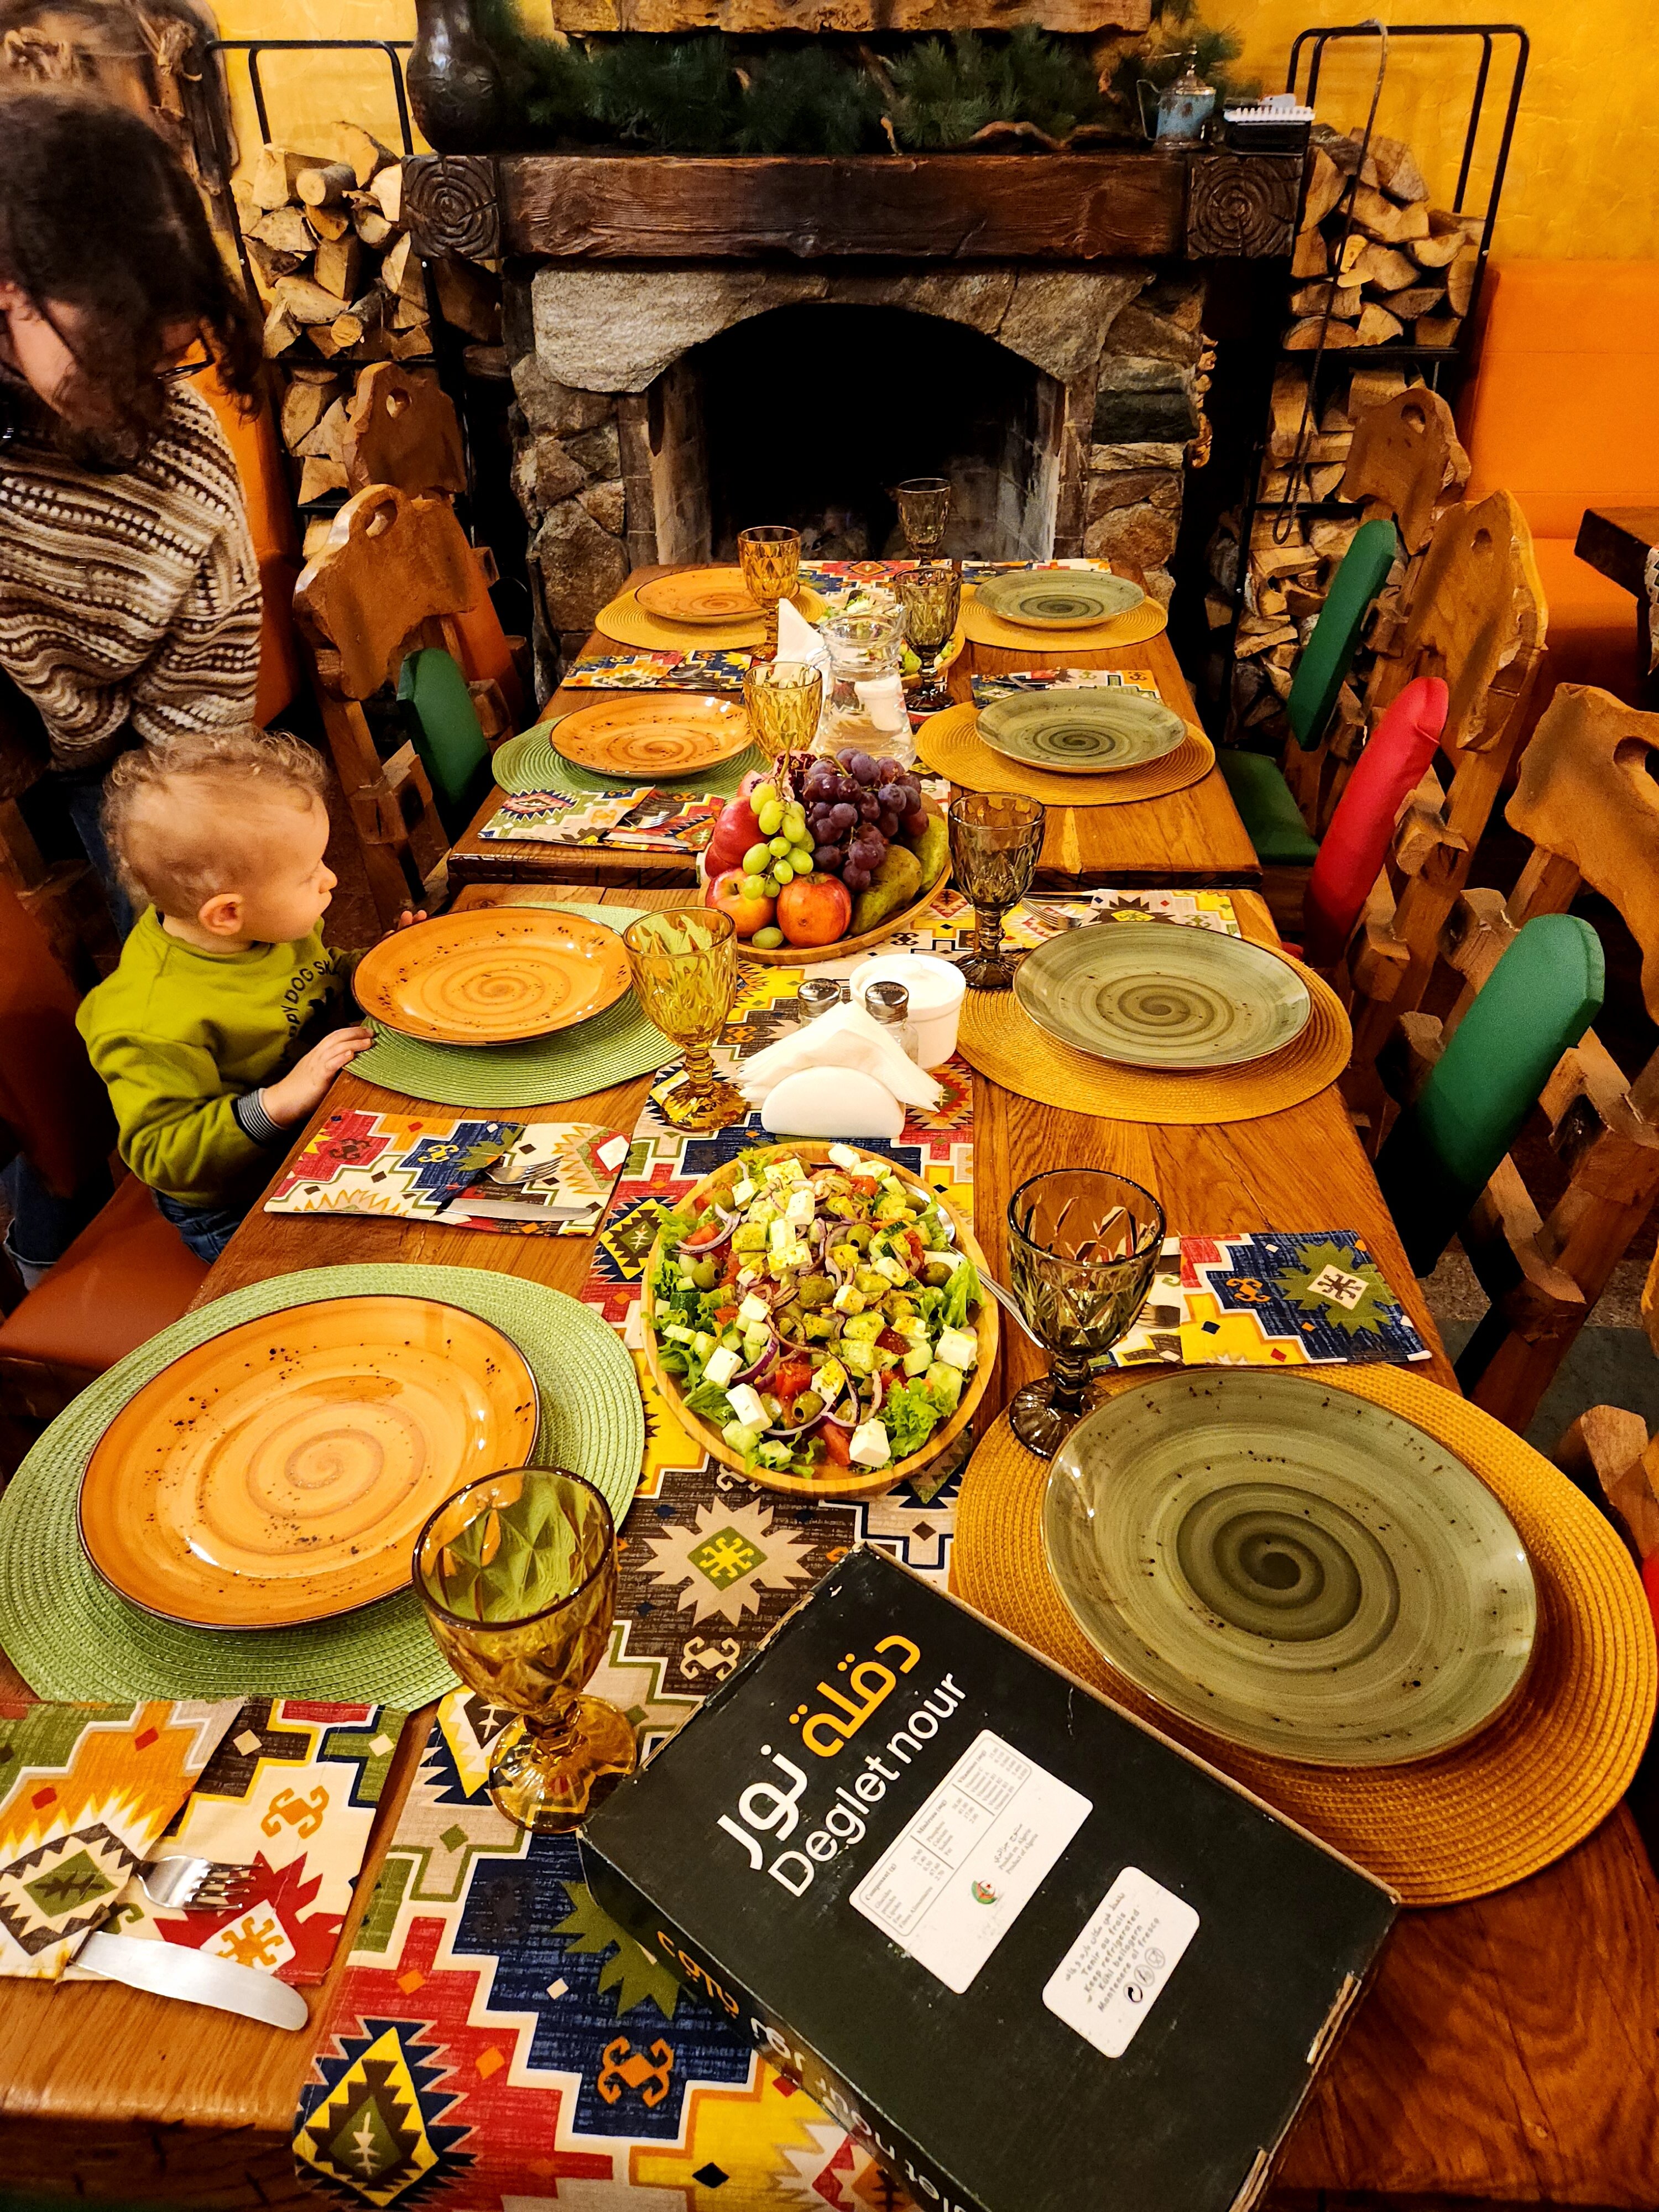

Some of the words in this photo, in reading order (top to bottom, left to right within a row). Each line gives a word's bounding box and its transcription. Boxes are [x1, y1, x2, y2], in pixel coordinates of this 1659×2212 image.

[284, 968, 314, 1004] DOG
[789, 1635, 921, 1757] دقلة
[717, 1744, 808, 1870] نور
[768, 1755, 900, 1897] Deglet
[886, 1673, 966, 1764] nour
[1081, 1951, 1100, 1975] Tenir
[1100, 1937, 1110, 1950] au
[1108, 1912, 1126, 1936] frais
[1083, 1970, 1102, 1993] Keep
[1101, 1908, 1140, 1968] refrigerated
[1131, 1948, 1139, 1960] al
[1137, 1917, 1160, 1947] fresco
